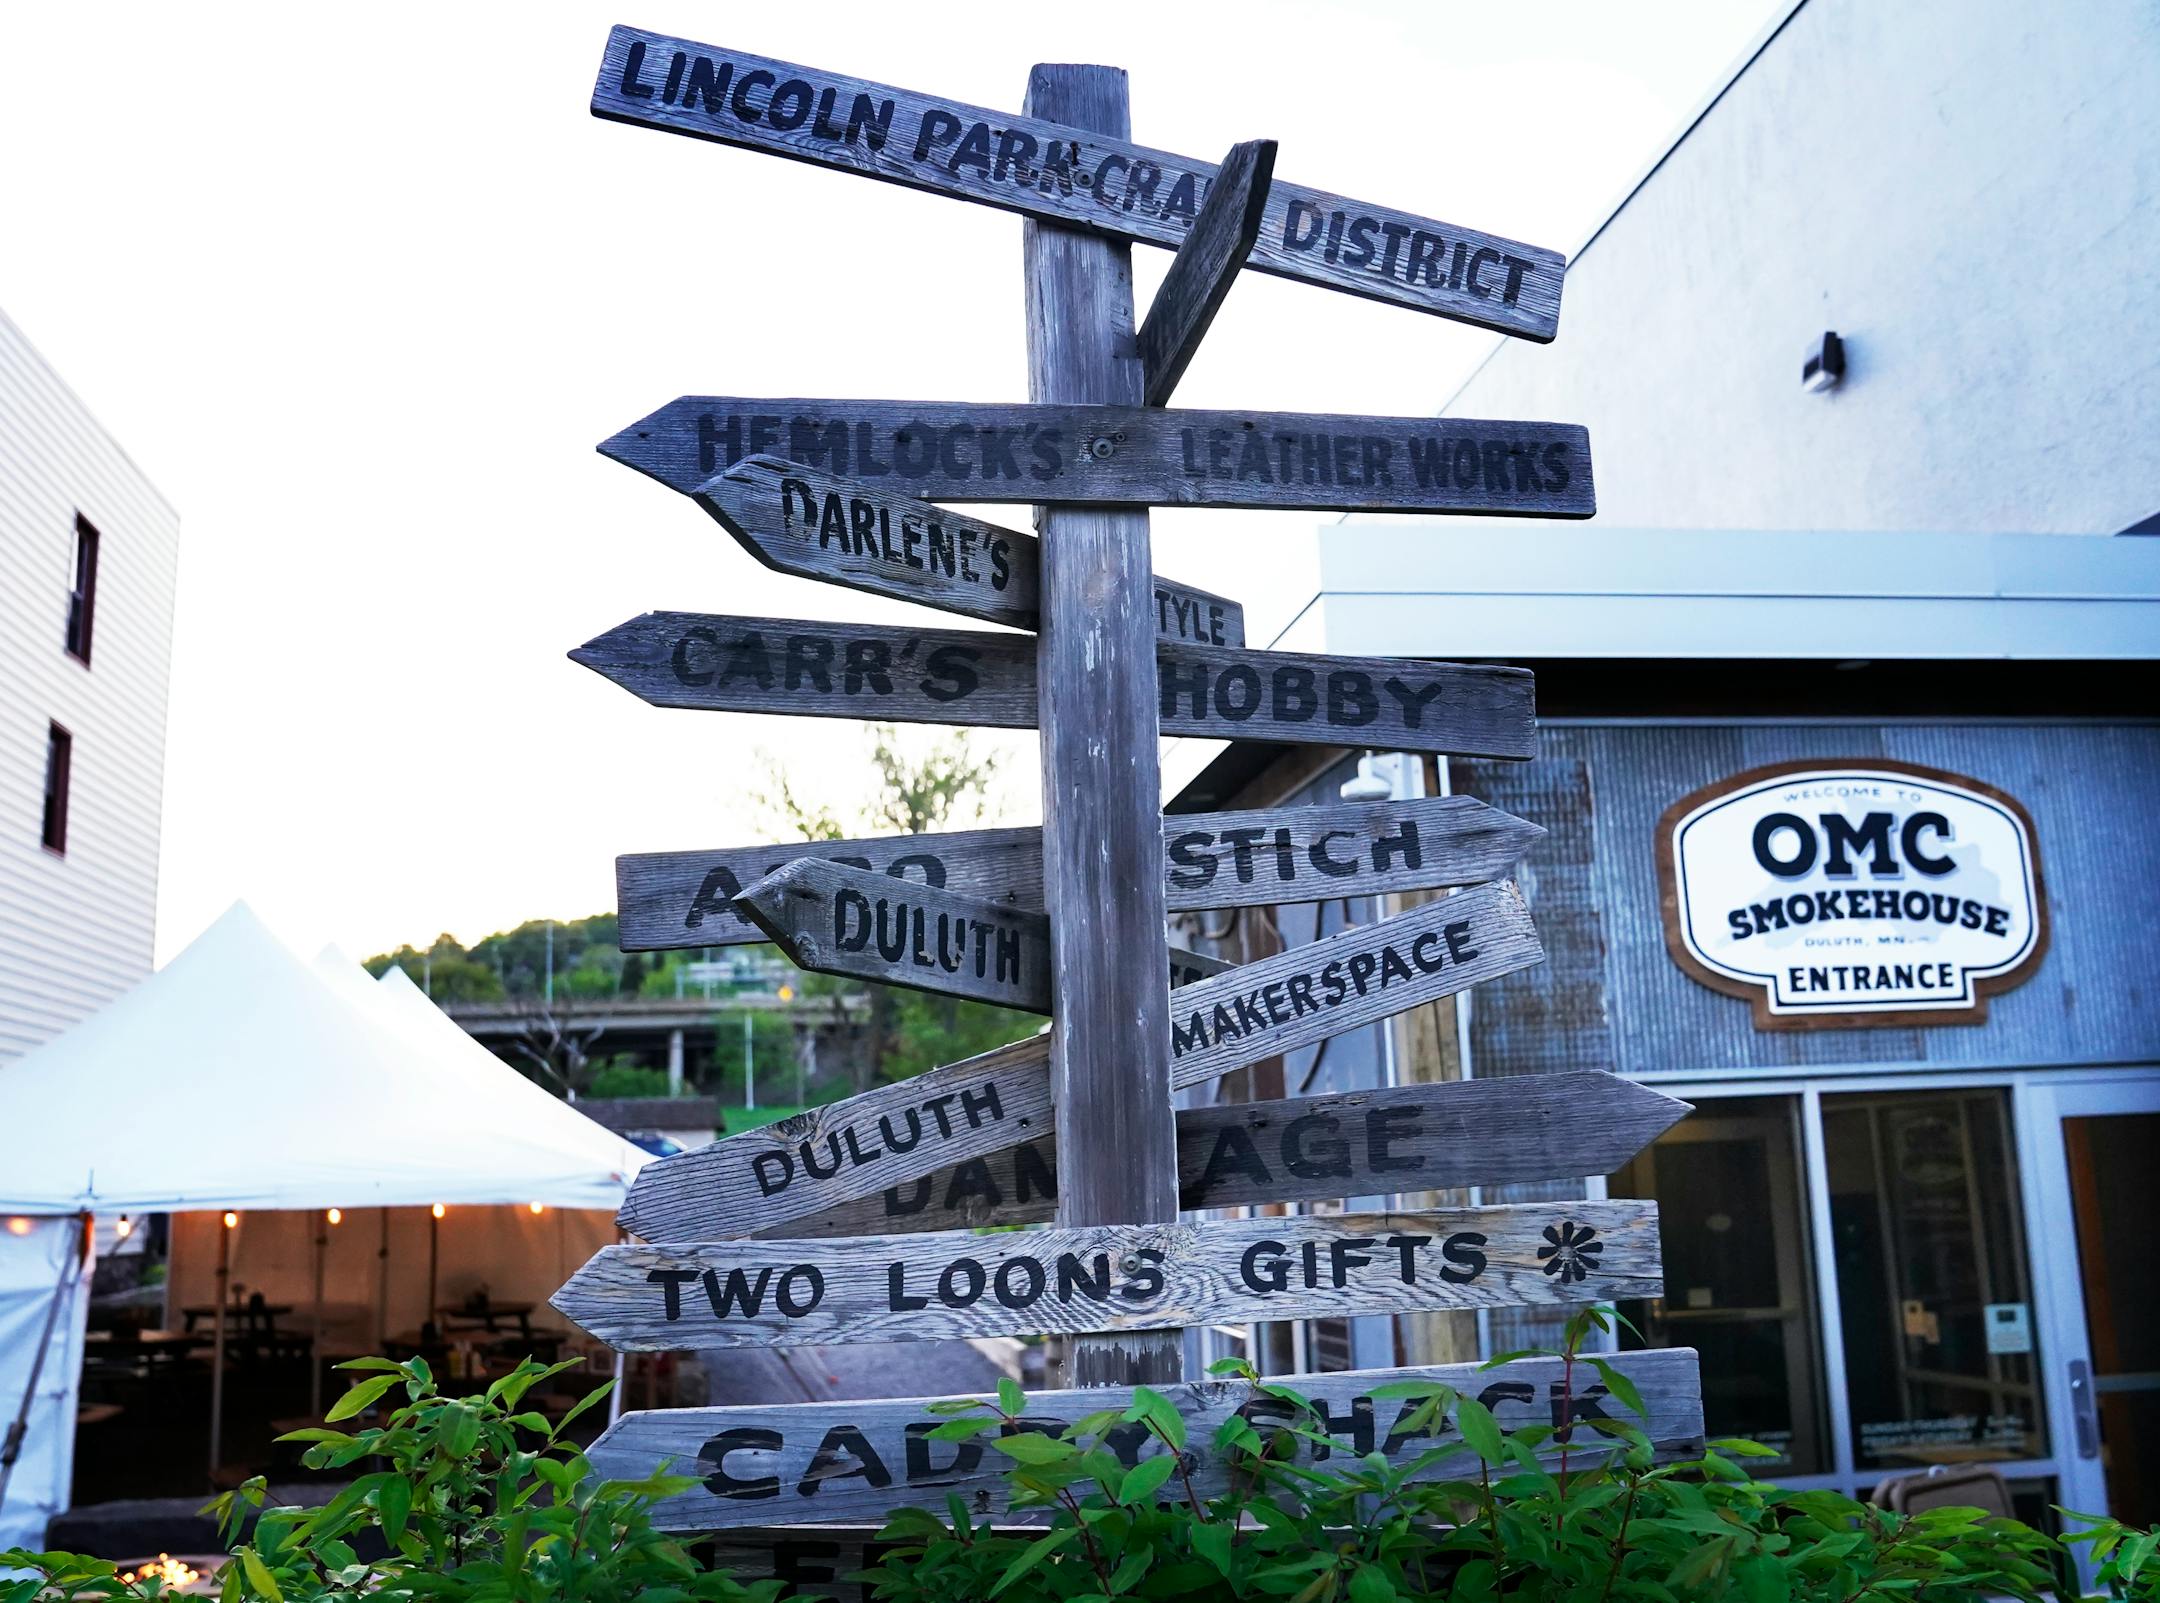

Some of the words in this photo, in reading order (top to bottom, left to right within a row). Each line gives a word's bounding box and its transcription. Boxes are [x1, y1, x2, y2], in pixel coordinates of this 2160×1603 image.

[620, 41, 895, 153] LINCOLN
[913, 109, 1080, 198] PARK
[1092, 154, 1213, 227] CRA
[1282, 199, 1535, 309] DISTRICT
[699, 414, 1063, 481] HEMLOCK'S
[1181, 427, 1393, 486] LEATHER
[1407, 436, 1570, 494] WORKS
[781, 478, 1010, 591] DARLENE'S
[671, 626, 982, 701] CARR'S
[1160, 662, 1442, 729] HOBBY
[1784, 786, 1881, 802] WELCOME
[1898, 790, 1922, 803] TO
[1169, 821, 1422, 888] STICH
[1752, 811, 1958, 879] OMC
[834, 888, 1020, 985] DULUTH
[1727, 888, 2011, 941] SMOKEHOUSE
[1789, 963, 1954, 994] ENTRANCE
[752, 1081, 1005, 1198] DULUTH
[1171, 920, 1480, 1059] MAKERSPACE
[647, 1263, 826, 1321] TWO
[888, 1249, 1166, 1313] LOONS
[1240, 1232, 1489, 1293] GIFTS
